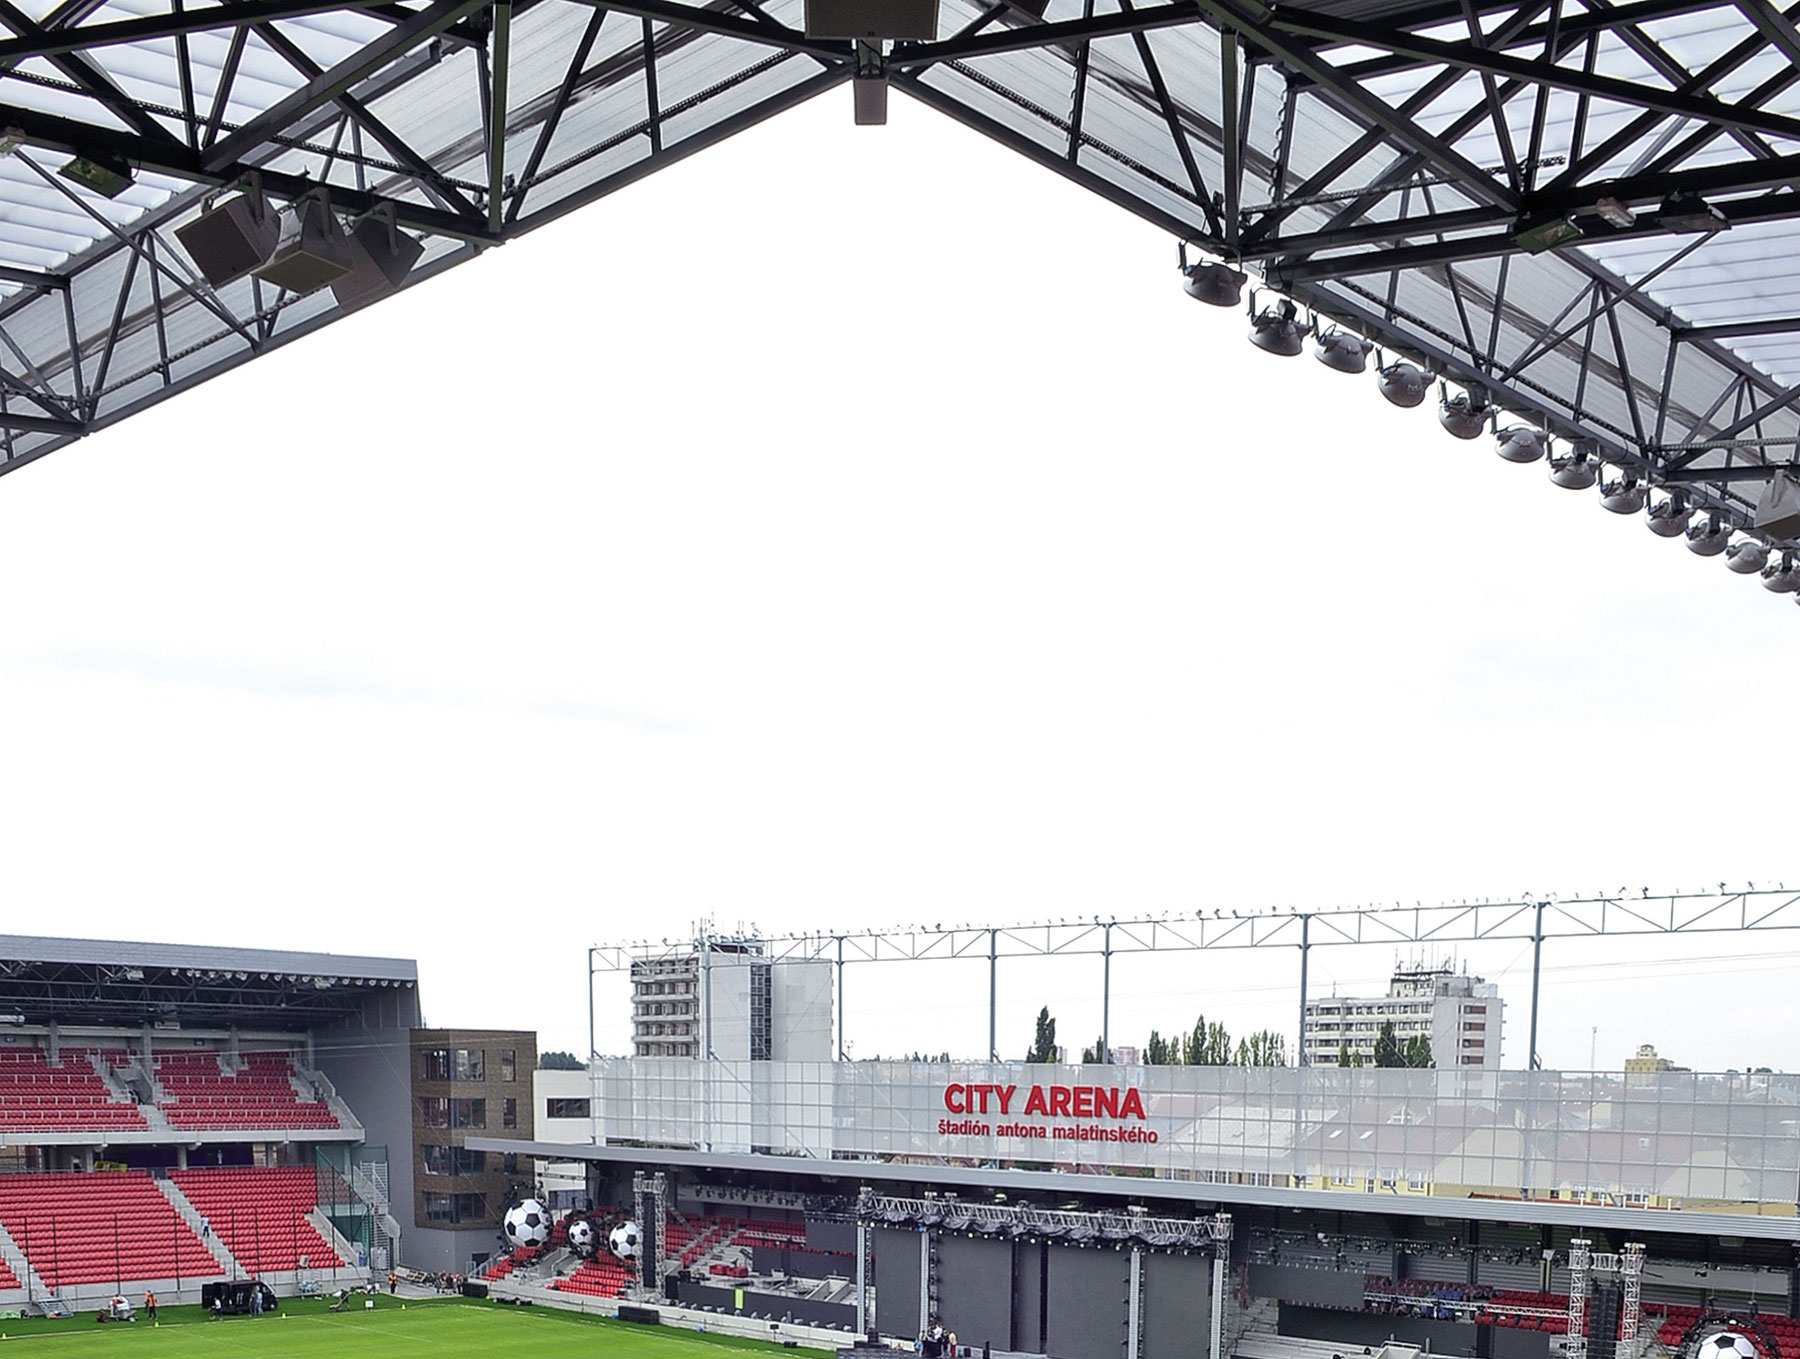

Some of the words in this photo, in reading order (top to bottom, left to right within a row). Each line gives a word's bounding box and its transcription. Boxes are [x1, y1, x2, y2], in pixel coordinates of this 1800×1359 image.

[944, 1083, 1016, 1115] CITY
[1024, 1085, 1146, 1120] ARENA
[938, 1118, 990, 1136] štadión
[996, 1121, 1047, 1139] antona
[1053, 1124, 1159, 1144] malatinského
